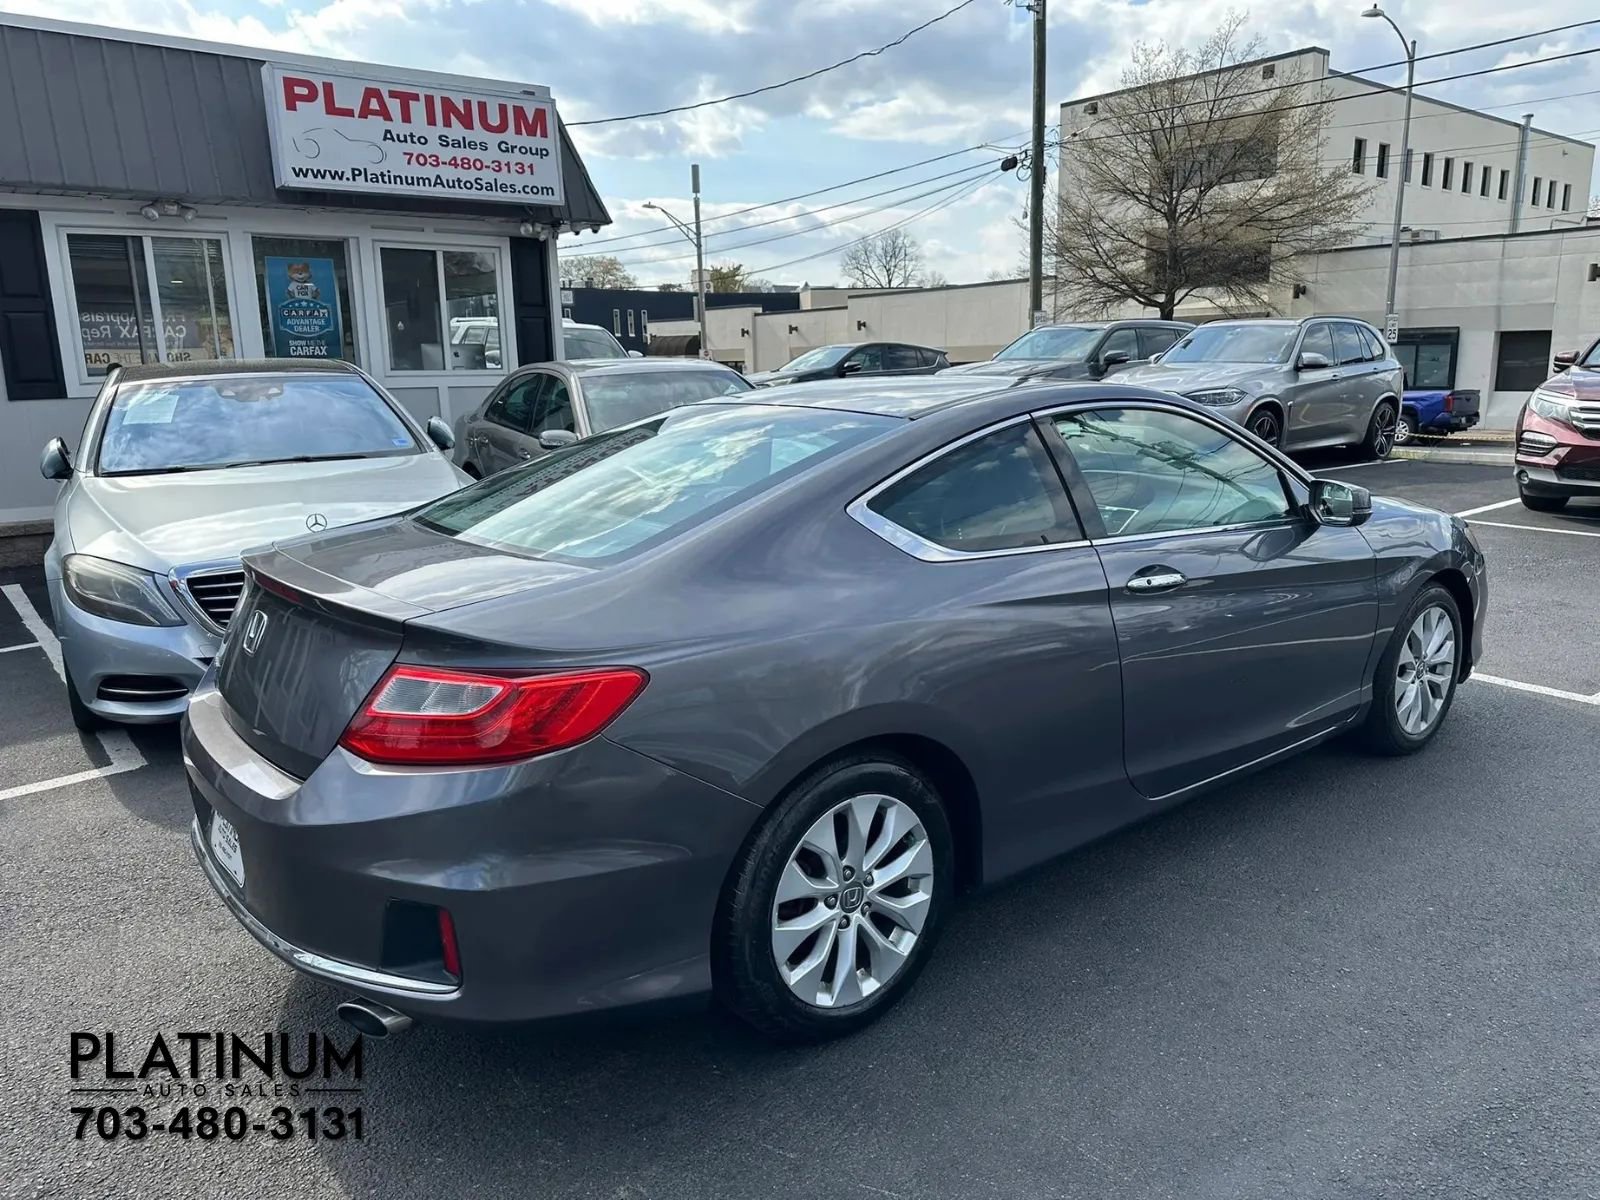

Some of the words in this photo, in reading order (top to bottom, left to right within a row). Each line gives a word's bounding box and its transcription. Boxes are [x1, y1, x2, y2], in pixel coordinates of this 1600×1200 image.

[282, 76, 549, 139] PLATINUM
[382, 129, 428, 146] Auto
[438, 134, 488, 151] Sales
[497, 140, 550, 158] Group
[403, 152, 535, 175] 703-480-3131
[292, 166, 555, 196] www.PlatinumAutoSales.com
[283, 309, 328, 318] CARFAX
[1387, 328, 1397, 340] 25
[290, 346, 328, 356] CARFAX
